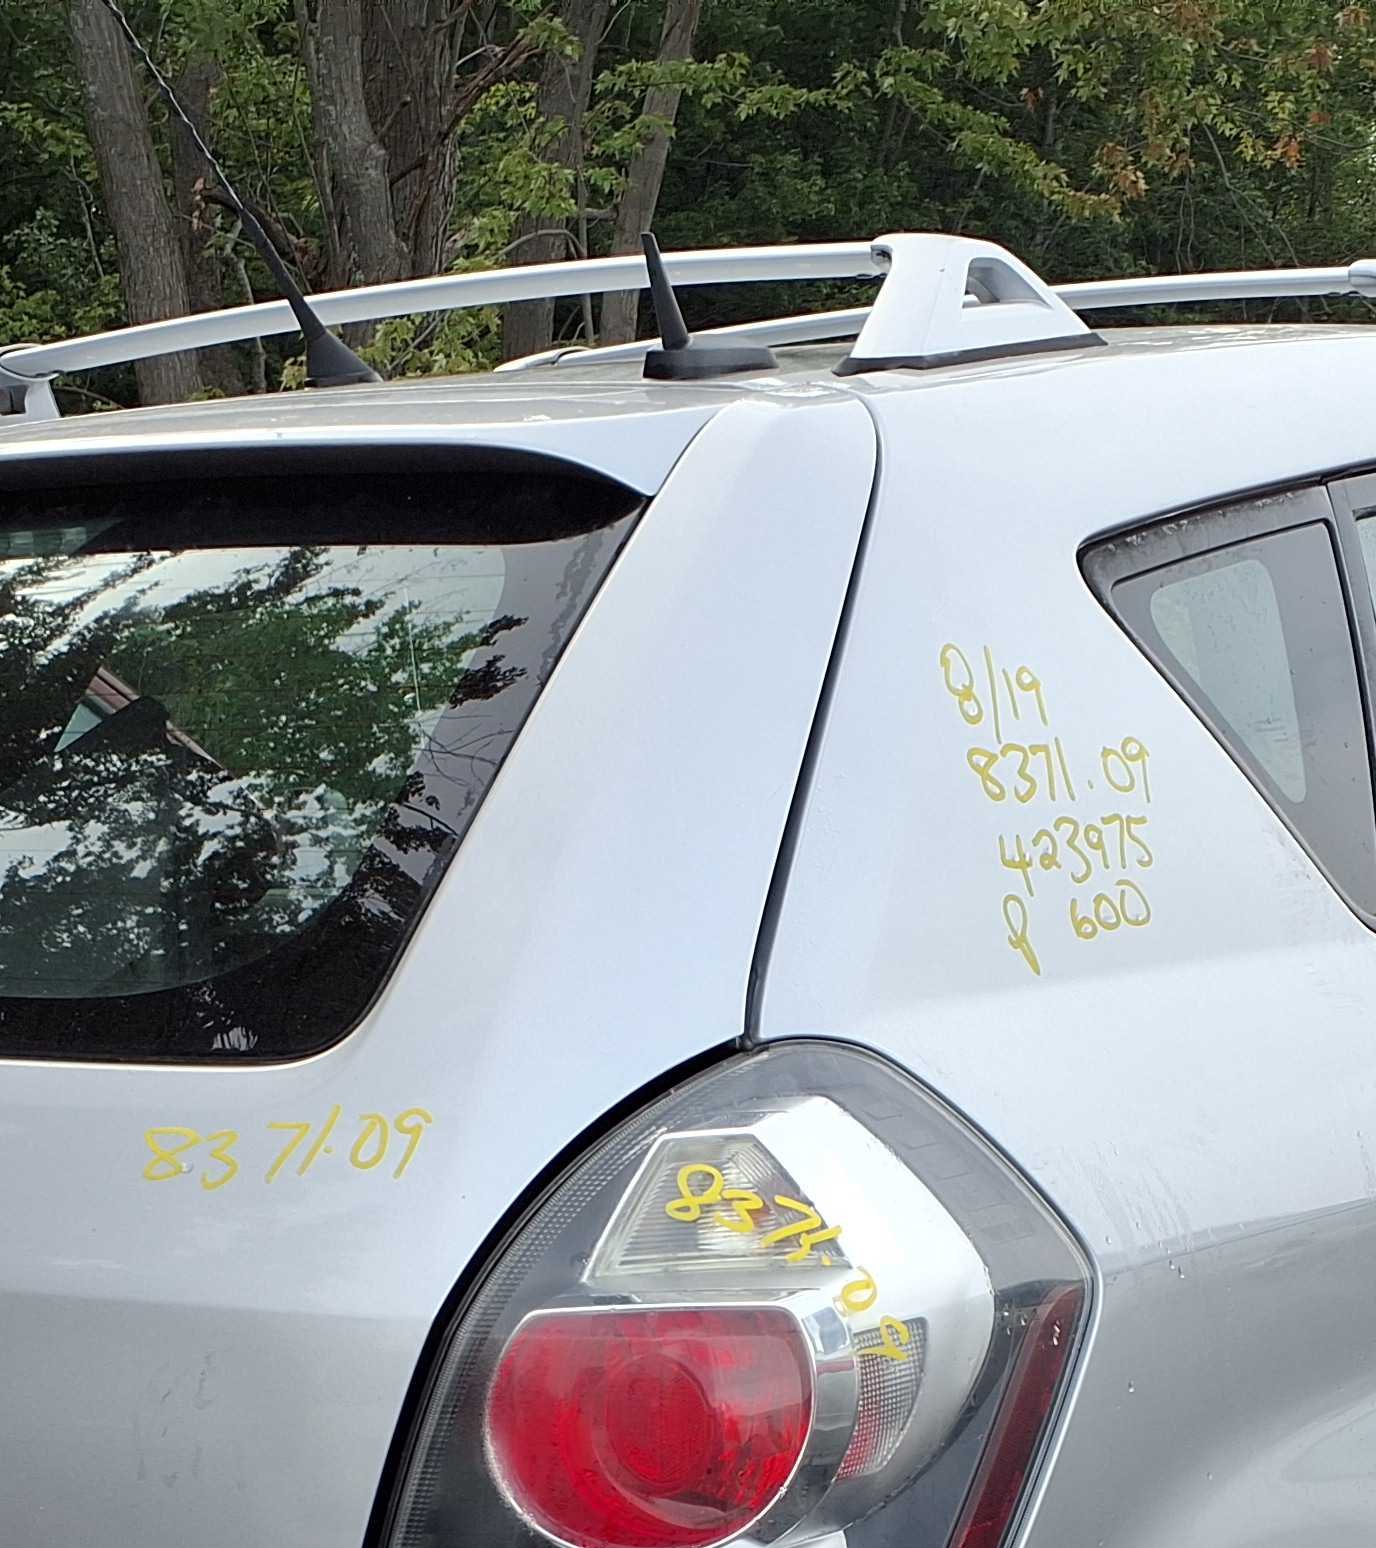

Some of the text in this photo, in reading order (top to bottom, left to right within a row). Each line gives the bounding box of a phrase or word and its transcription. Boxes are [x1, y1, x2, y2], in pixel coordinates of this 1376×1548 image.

[939, 643, 1048, 744] 8/19
[967, 736, 1151, 803] 8371.09
[999, 813, 1153, 897] 423975
[1070, 878, 1151, 940] 600
[141, 1106, 432, 1190] 8371.09
